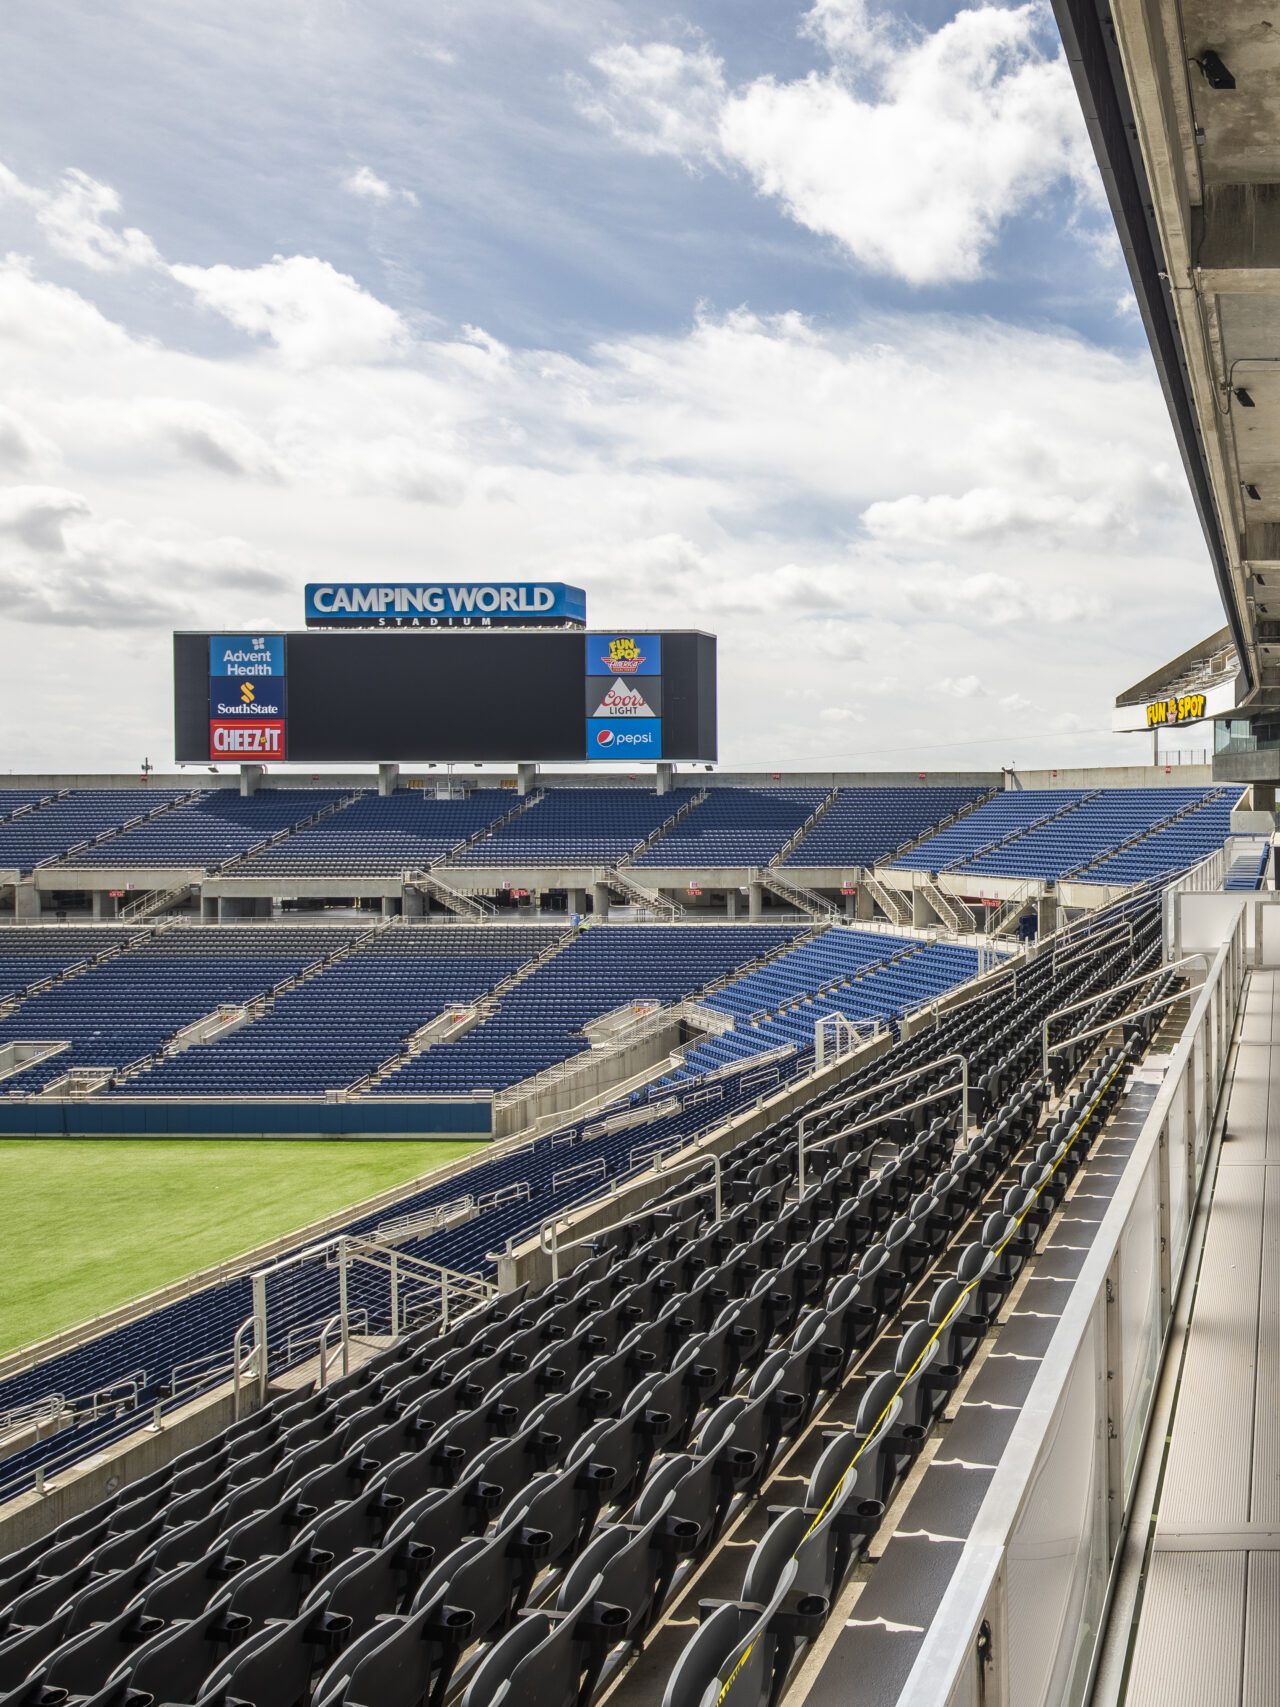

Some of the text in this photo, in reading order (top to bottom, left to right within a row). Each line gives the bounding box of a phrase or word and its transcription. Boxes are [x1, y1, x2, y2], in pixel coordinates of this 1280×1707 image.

[313, 587, 555, 612] CAMPING WORLD
[378, 617, 492, 626] STADIUM
[609, 638, 635, 652] FUN
[223, 650, 272, 662] Advent
[610, 648, 641, 660] SPOT
[227, 663, 272, 676] Health
[601, 690, 647, 707] Coors
[217, 703, 279, 714] SouthState
[609, 706, 638, 715] LIGHT
[1147, 701, 1167, 727] FUN
[1178, 693, 1206, 721] SPOT
[616, 732, 652, 746] pepsi
